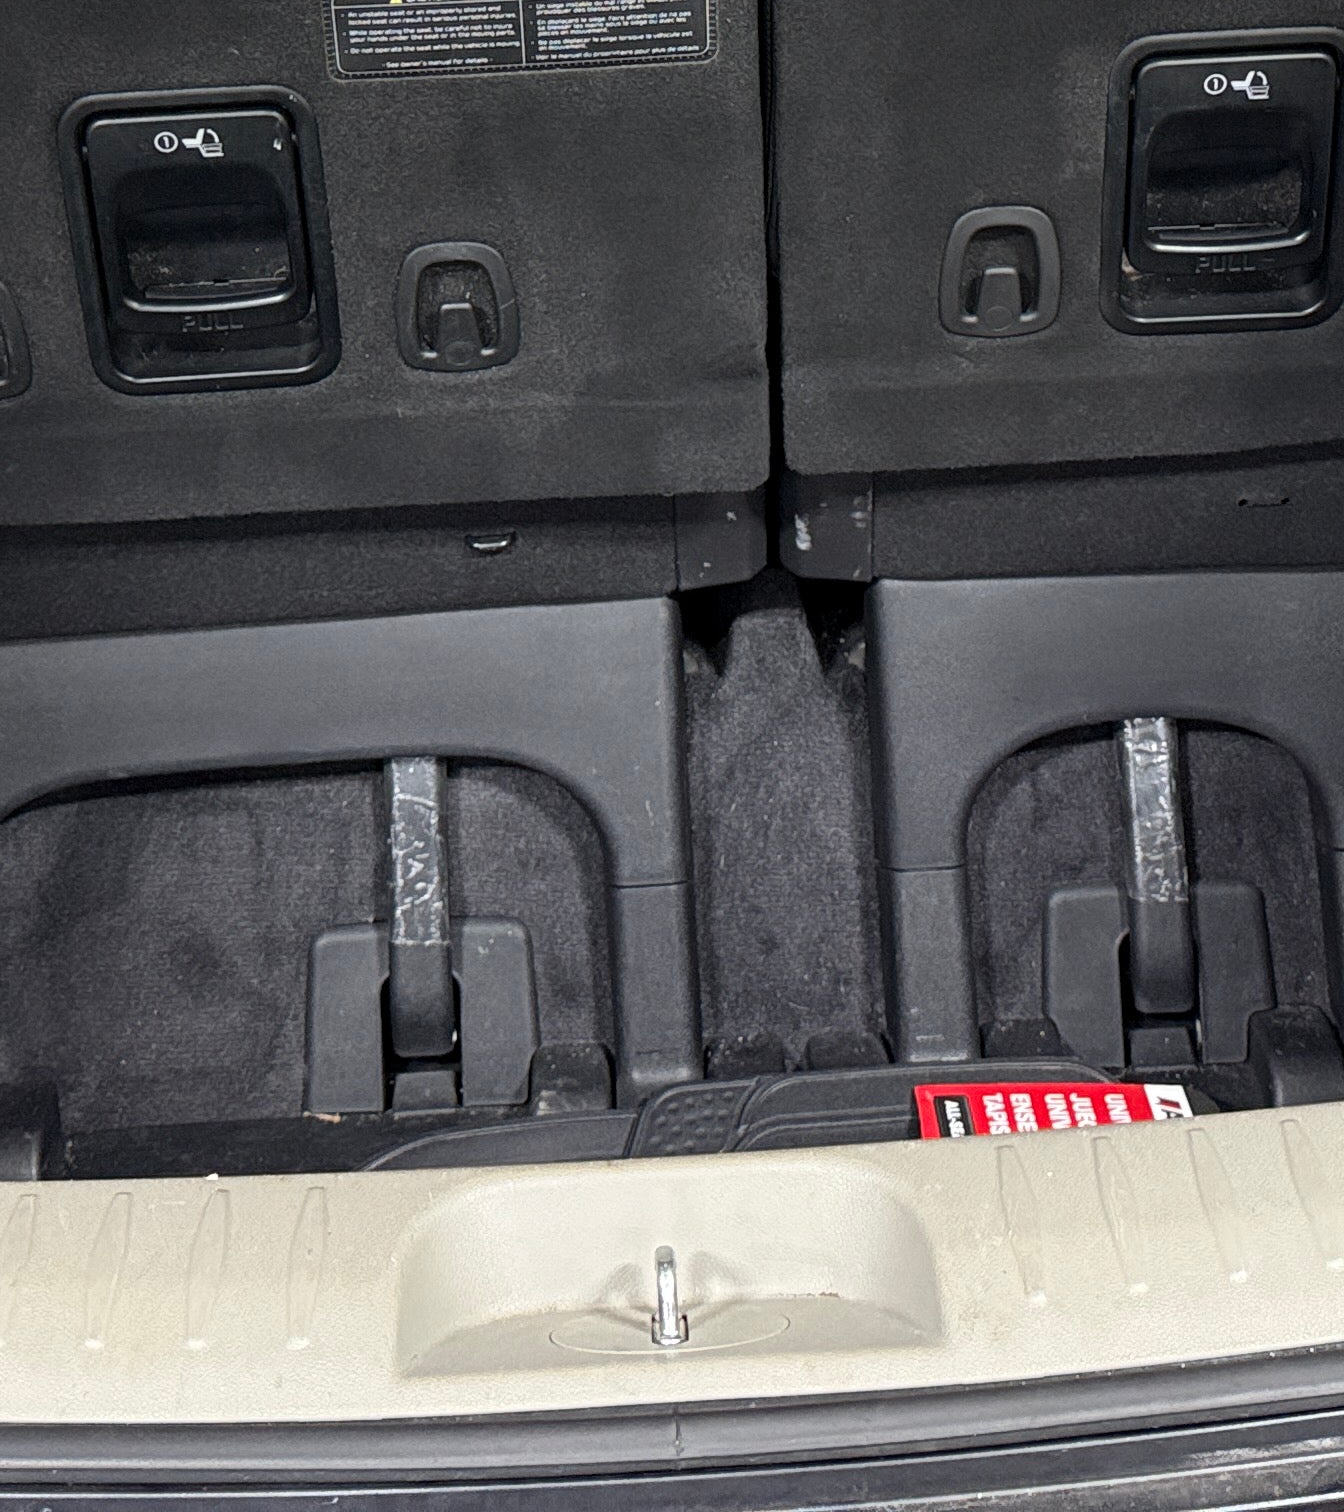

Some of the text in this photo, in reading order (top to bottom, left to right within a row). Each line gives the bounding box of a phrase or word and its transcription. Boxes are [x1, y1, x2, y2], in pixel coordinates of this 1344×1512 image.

[1195, 253, 1256, 273] PULL
[182, 313, 244, 333] PULL
[943, 1099, 965, 1138] ALL-SE
[981, 1092, 1012, 1135] TAPIS
[1009, 1092, 1038, 1133] ENSE
